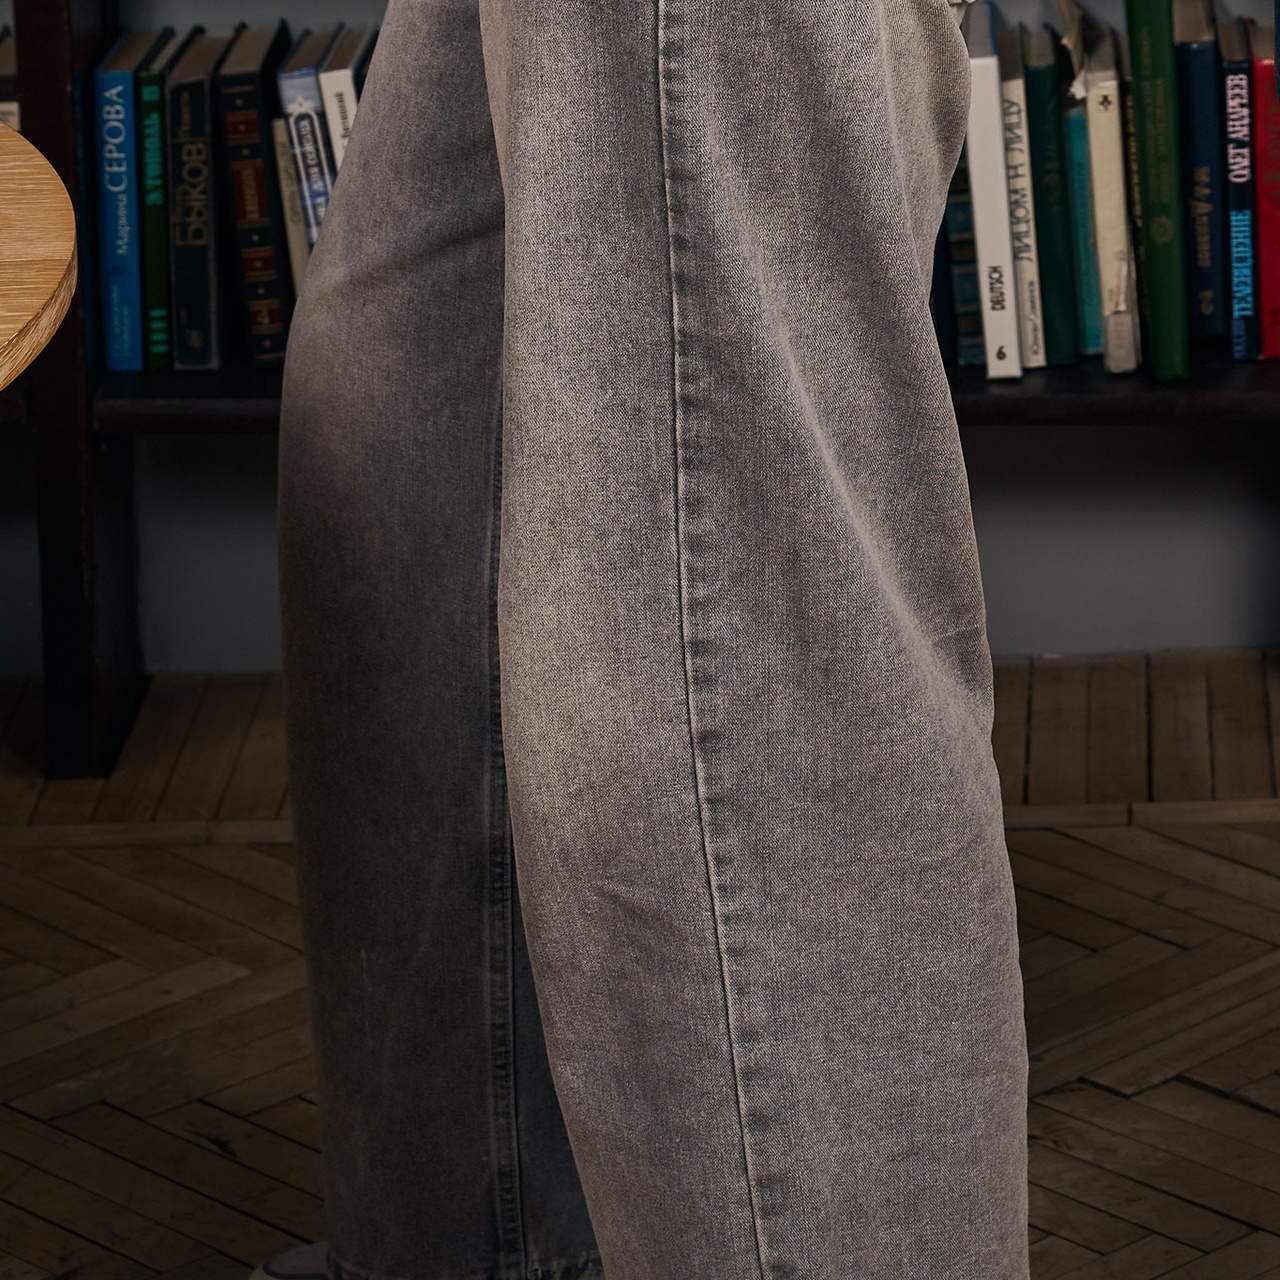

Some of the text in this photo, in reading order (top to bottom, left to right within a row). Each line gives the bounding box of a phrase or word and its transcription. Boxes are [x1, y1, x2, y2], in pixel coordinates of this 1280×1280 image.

[1002, 98, 1027, 155] ЛИЦУ
[102, 84, 132, 256] Марина СЕРОВА
[174, 142, 209, 247] БЫКОВ
[1225, 75, 1253, 318] ТЕЛЕВИДЕНИЕ ОЛЕГ АНДРЕЕВ
[1008, 187, 1035, 263] ЛИЦОМ
[988, 265, 1007, 311] DEUTSCH
[995, 345, 1007, 361] 6
